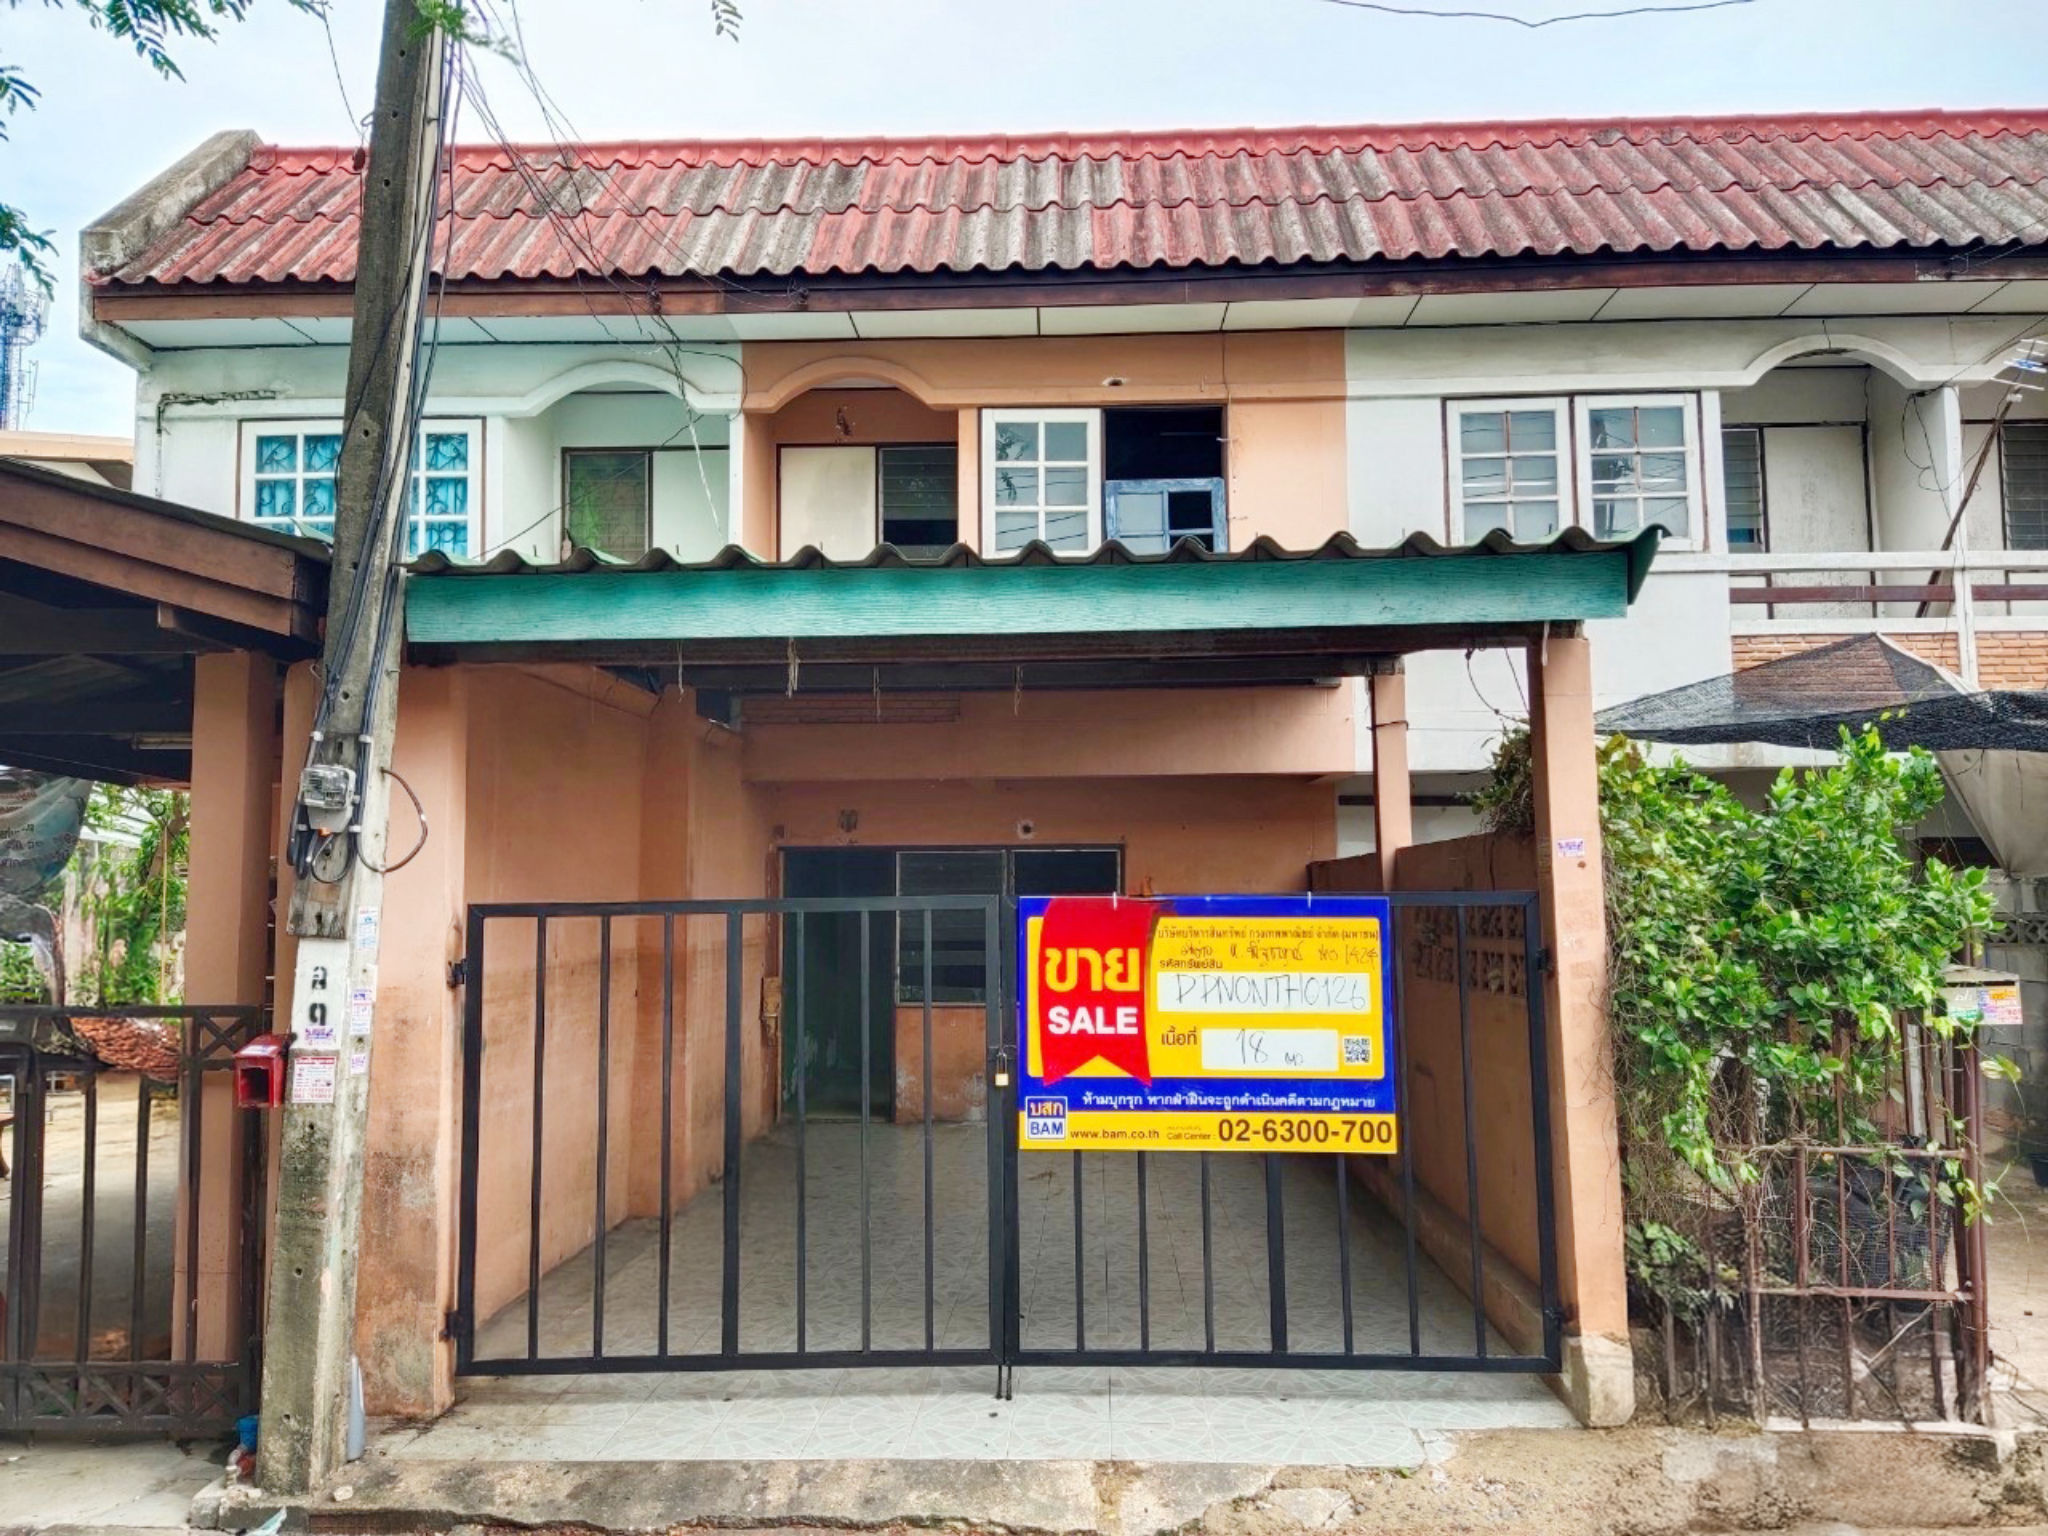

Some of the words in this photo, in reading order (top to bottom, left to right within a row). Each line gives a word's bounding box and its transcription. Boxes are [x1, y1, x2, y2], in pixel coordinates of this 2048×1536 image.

[1045, 948, 1140, 992] ขาย
[1048, 1006, 1138, 1034] SALE
[1161, 1026, 1198, 1046] เนื้อที่
[1236, 1029, 1268, 1064] 18
[1030, 1101, 1064, 1117] บสก
[1082, 1091, 1143, 1109] ห้ามบุกรุก
[1030, 1121, 1063, 1136] BAM
[1070, 1128, 1160, 1140] www.bam.co.th
[1218, 1118, 1393, 1143] 02-6300-700
